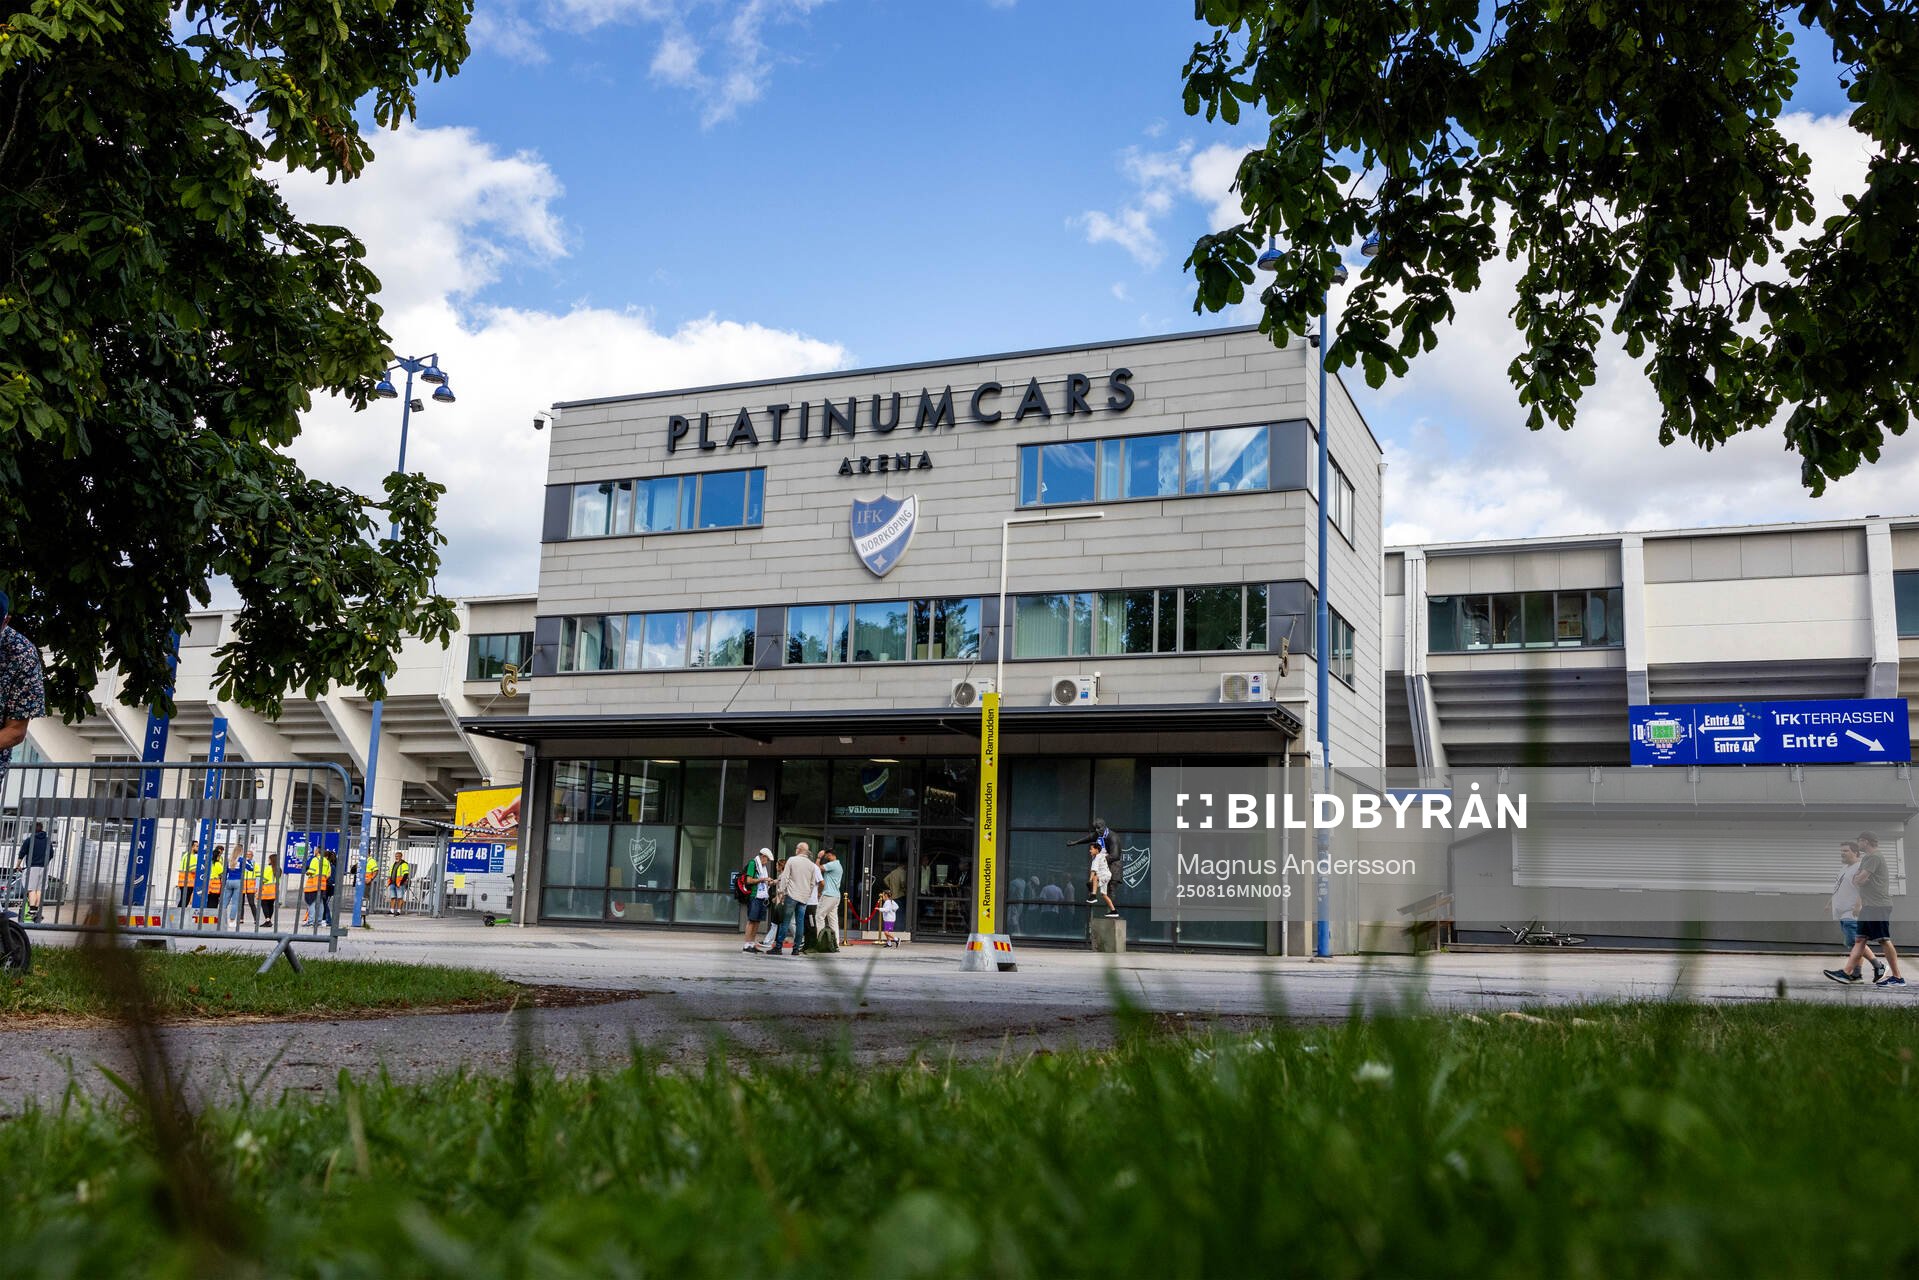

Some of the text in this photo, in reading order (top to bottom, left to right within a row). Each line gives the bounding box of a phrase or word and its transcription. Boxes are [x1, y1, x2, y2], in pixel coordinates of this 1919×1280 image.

[668, 367, 1135, 453] PLATINUMCARS
[838, 449, 933, 476] ARENA
[857, 509, 884, 524] IFK
[860, 509, 913, 553] NORRKÖPING
[1704, 714, 1745, 726] Entré 4B
[985, 708, 994, 755] Ramudden
[1782, 733, 1838, 749] Entré
[1714, 741, 1756, 753] Entré 4A
[848, 806, 900, 814] Välkommen
[983, 782, 993, 830] Ramudden
[450, 846, 488, 860] Entré 4B
[982, 857, 992, 907] Ramudden
